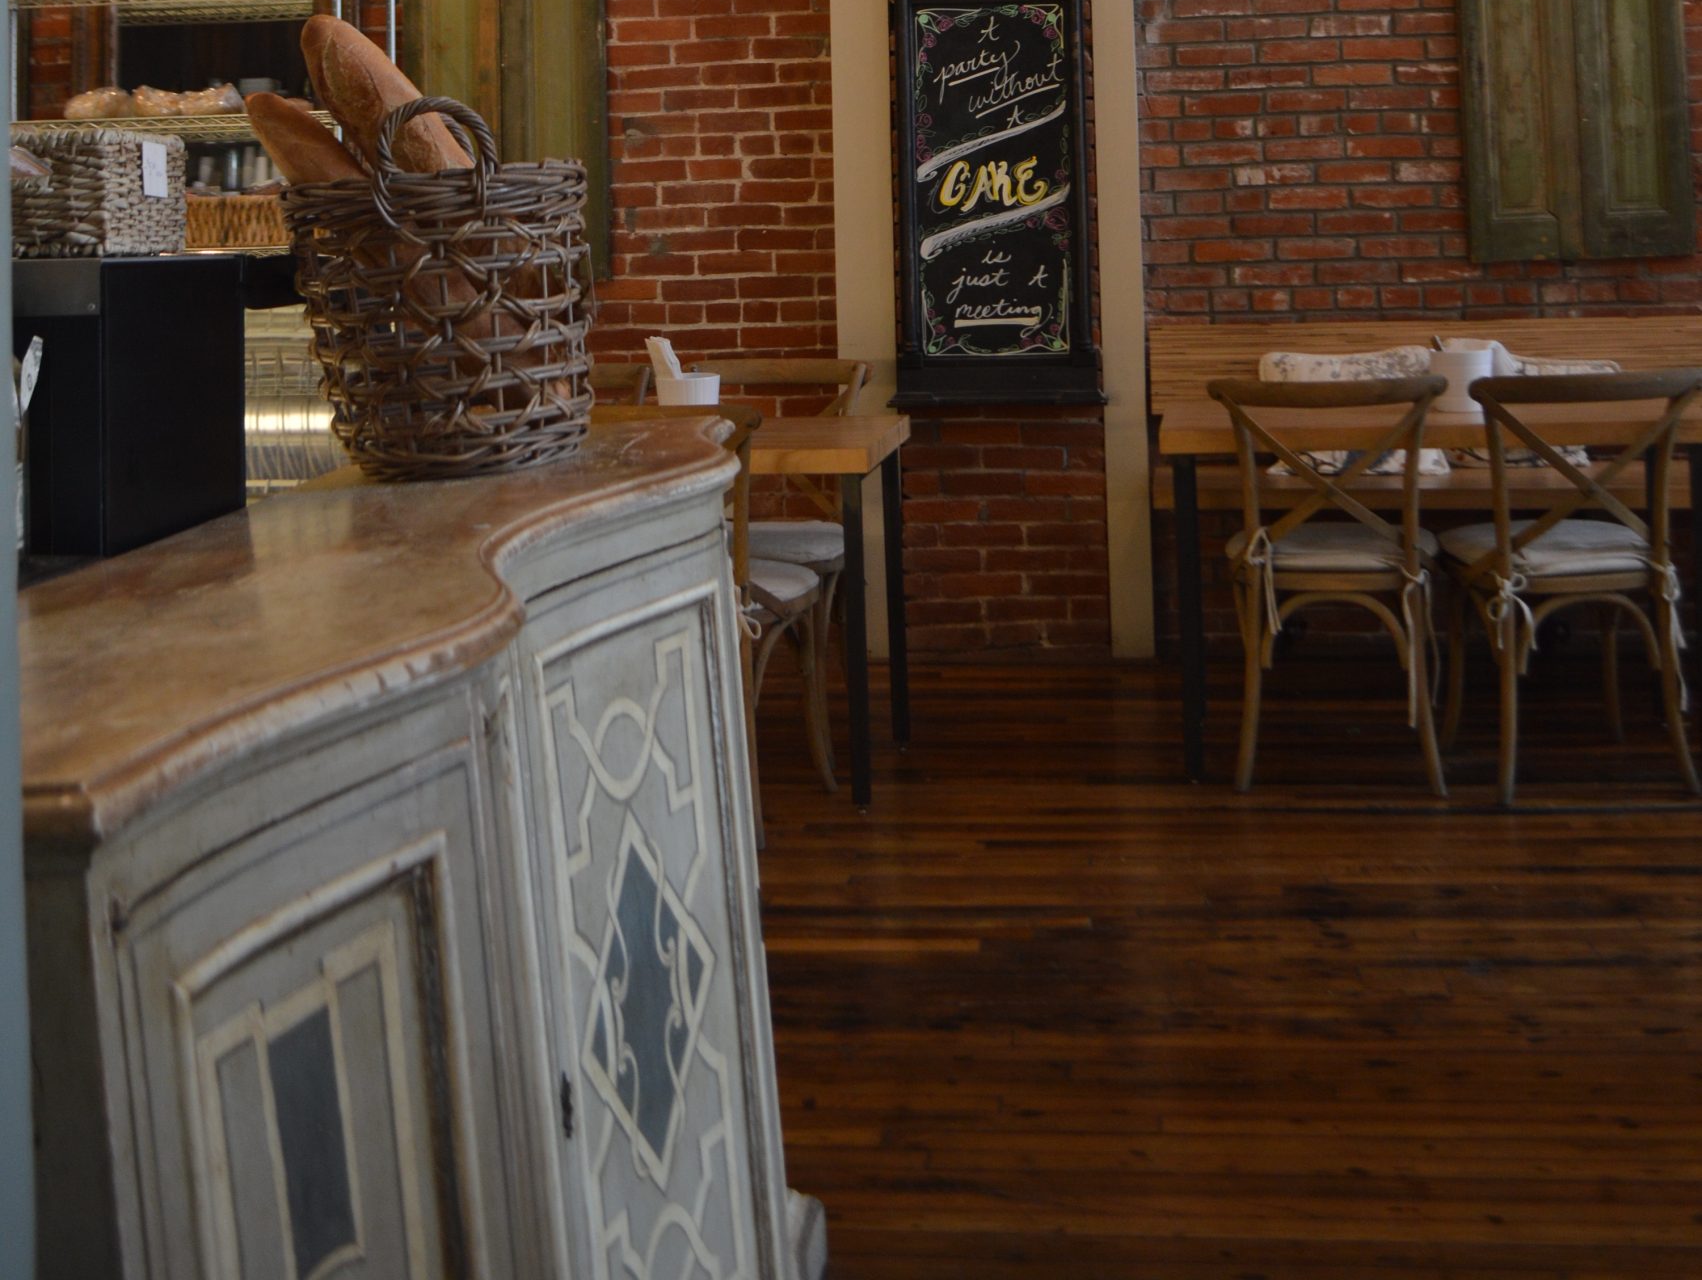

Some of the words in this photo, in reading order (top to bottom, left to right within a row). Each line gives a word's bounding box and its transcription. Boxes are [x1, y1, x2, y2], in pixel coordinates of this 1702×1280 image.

[933, 40, 1021, 104] party
[968, 53, 1064, 113] without
[939, 156, 1050, 212] CAKE
[981, 240, 1012, 264] is
[946, 267, 1010, 304] just
